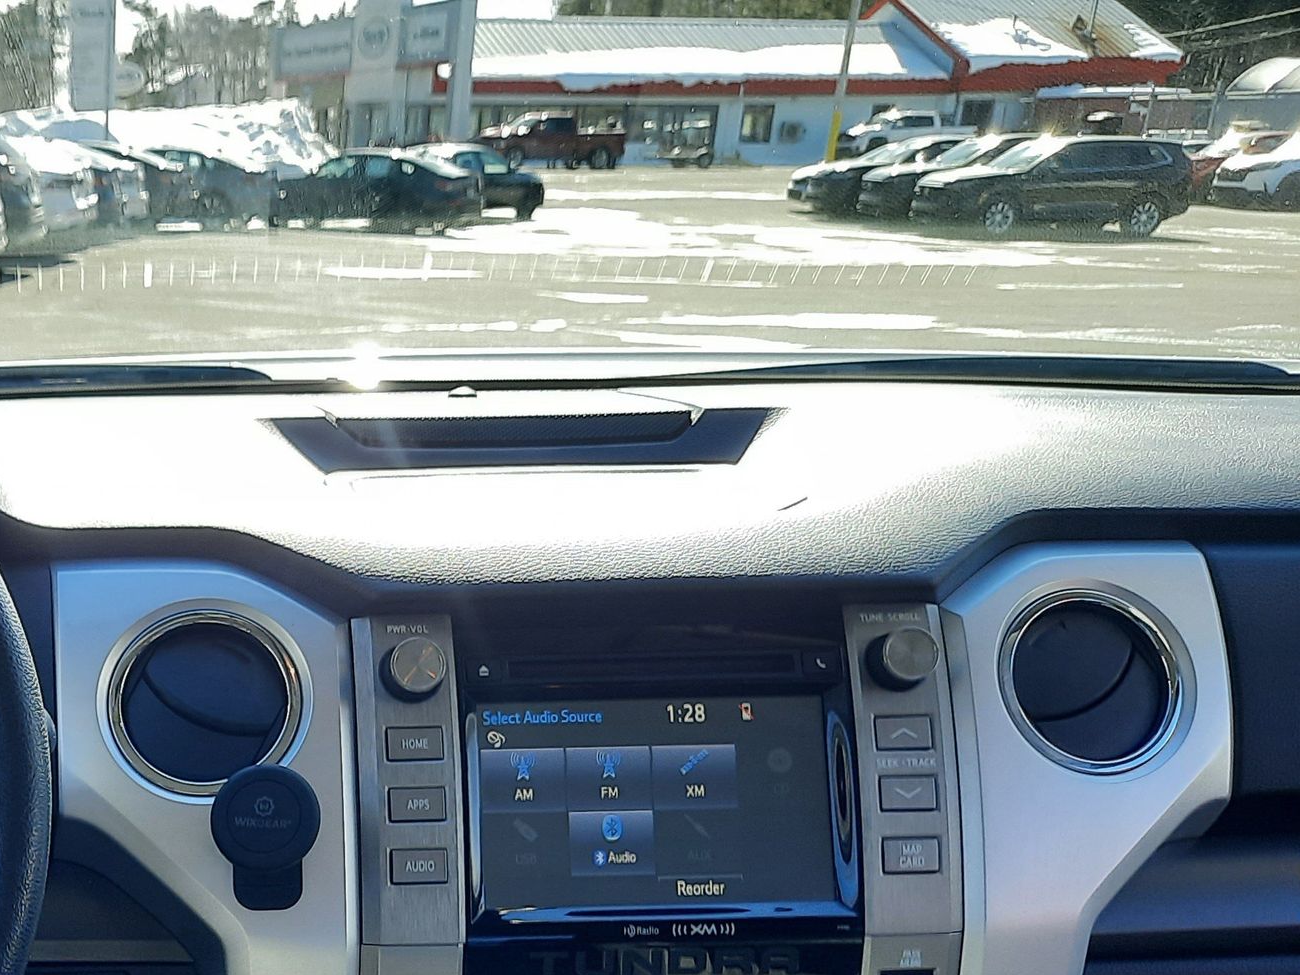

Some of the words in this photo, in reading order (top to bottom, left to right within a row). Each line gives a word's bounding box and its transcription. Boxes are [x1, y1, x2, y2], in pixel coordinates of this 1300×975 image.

[482, 709, 520, 726] Select
[523, 710, 559, 725] Audio
[561, 708, 604, 723] Source
[667, 703, 706, 723] 1:28
[401, 738, 428, 750] HOME
[515, 788, 534, 801] AM
[601, 786, 619, 799] FM
[686, 784, 705, 797] XM
[407, 799, 430, 811] APPS
[902, 844, 922, 855] MAP
[608, 851, 637, 864] Audio
[899, 856, 925, 868] CARD
[406, 860, 435, 872] AUDIO
[677, 880, 726, 896] Reorder
